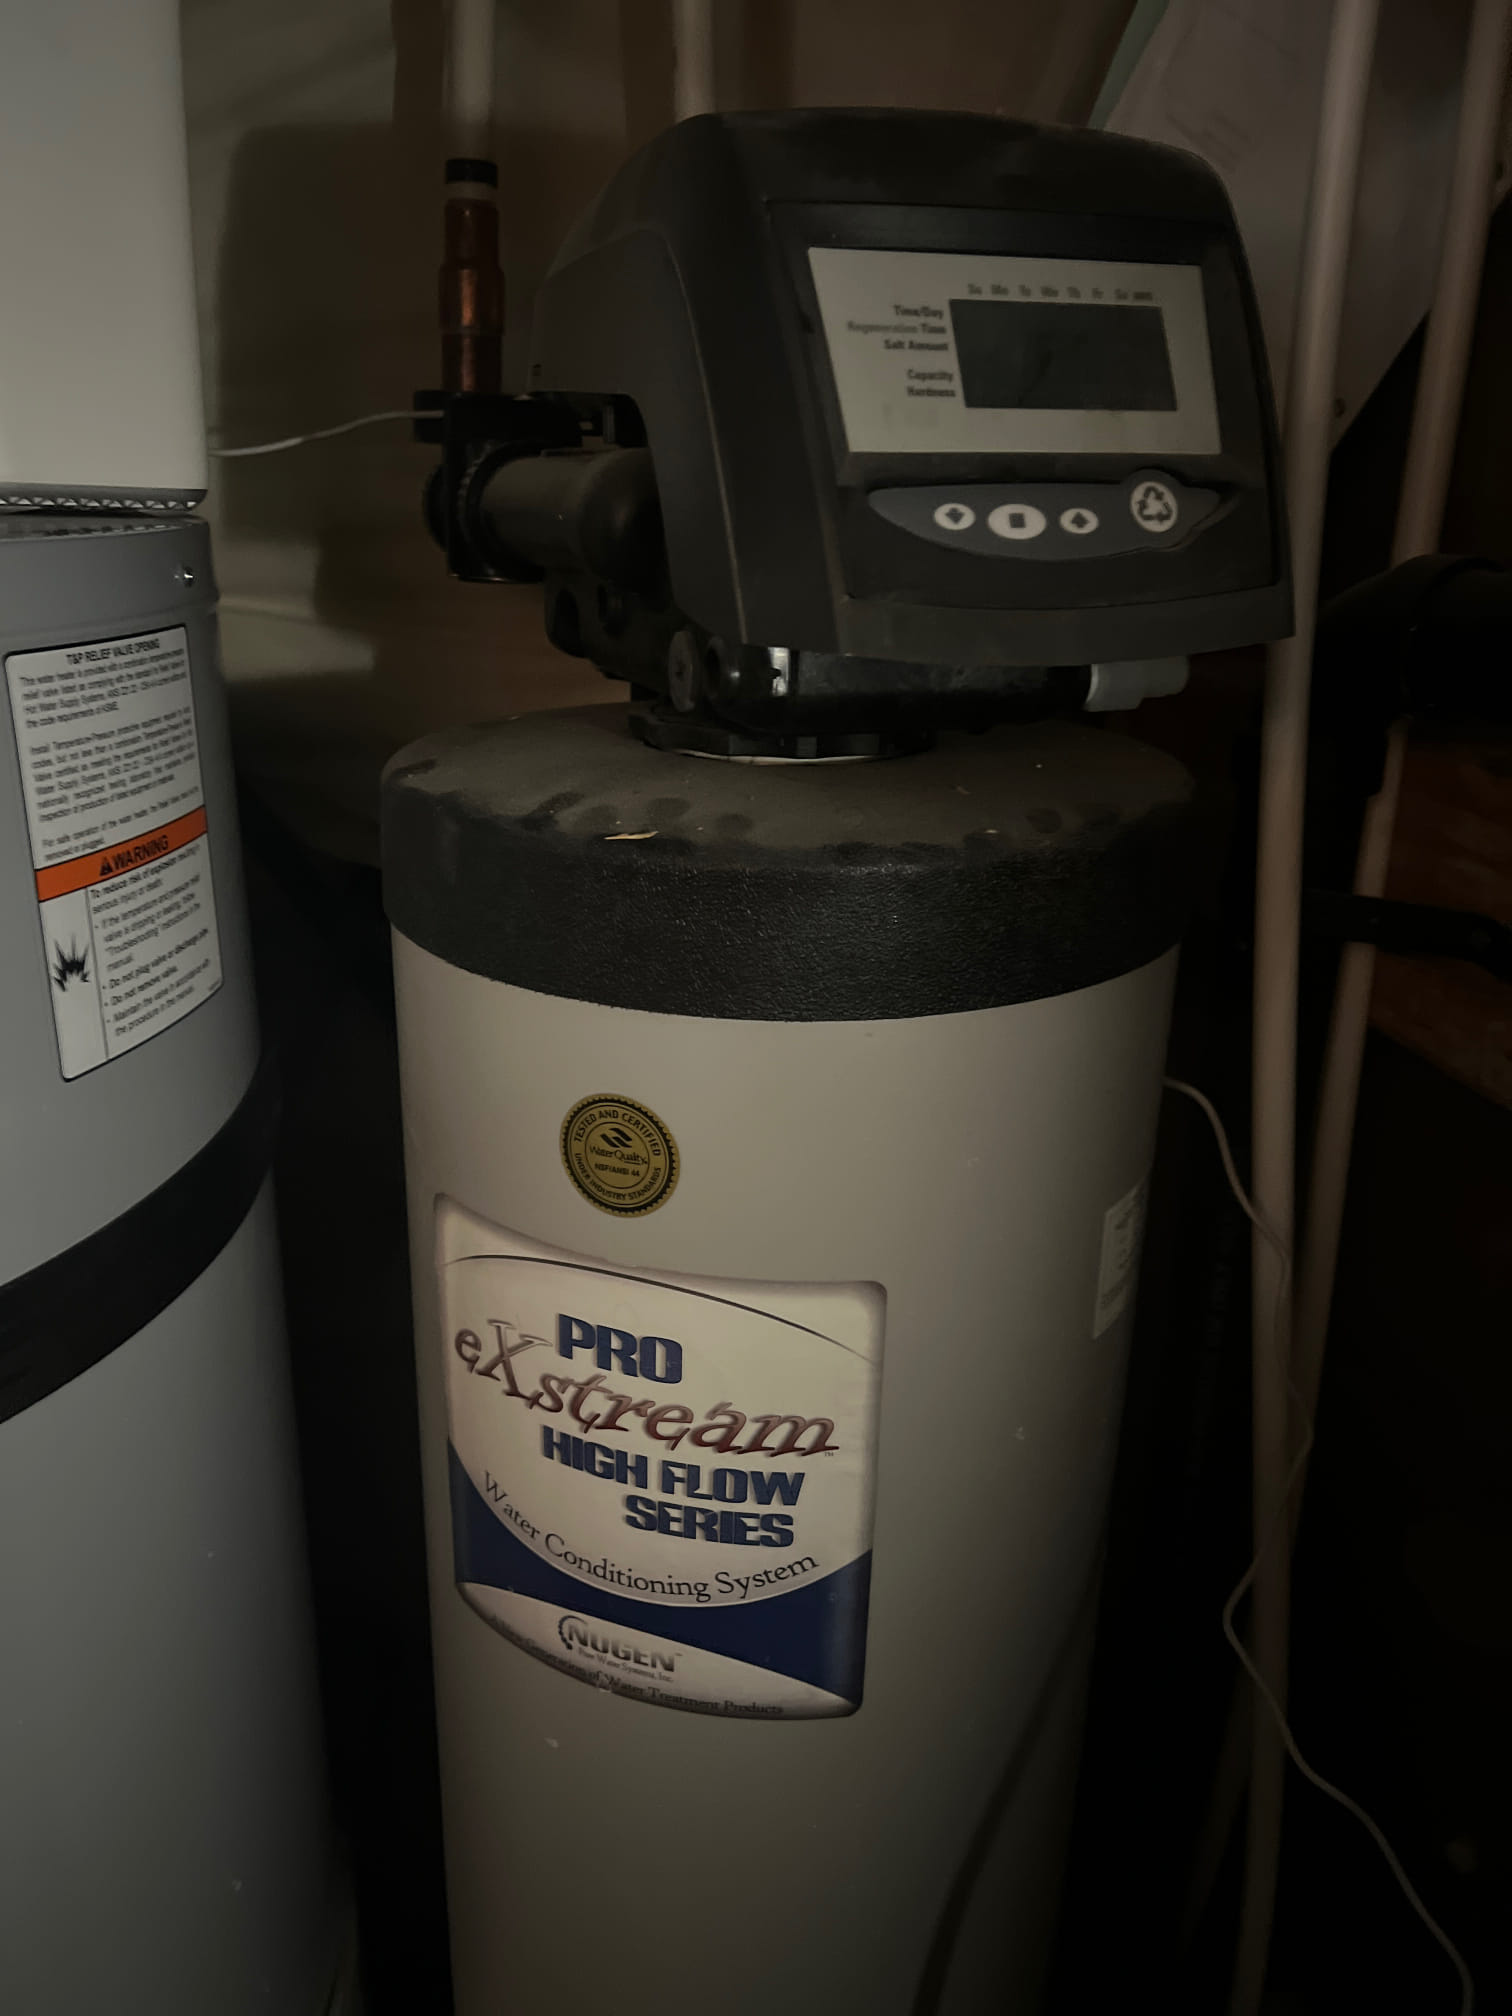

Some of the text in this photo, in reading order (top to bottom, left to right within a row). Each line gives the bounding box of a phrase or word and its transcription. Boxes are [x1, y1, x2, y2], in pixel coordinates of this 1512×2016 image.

[893, 304, 944, 320] Time/Day
[84, 648, 111, 662] RELIEF
[113, 643, 134, 657] VALVE
[113, 834, 169, 871] WARNING
[574, 1109, 662, 1157] TESTED AND CERTIFIED
[575, 1152, 662, 1201] UNDER INDUSTRY STANDARDS
[557, 1313, 684, 1385] PRO
[455, 1319, 840, 1458] eXstream
[542, 1425, 806, 1507] HIGH FLOW
[483, 1474, 819, 1604] Water Conditioning System
[622, 1494, 795, 1548] SERIES
[563, 1616, 676, 1673] NUGEN
[604, 1676, 647, 1698] Water
[648, 1685, 720, 1712] Treatment
[724, 1701, 784, 1715] Products
